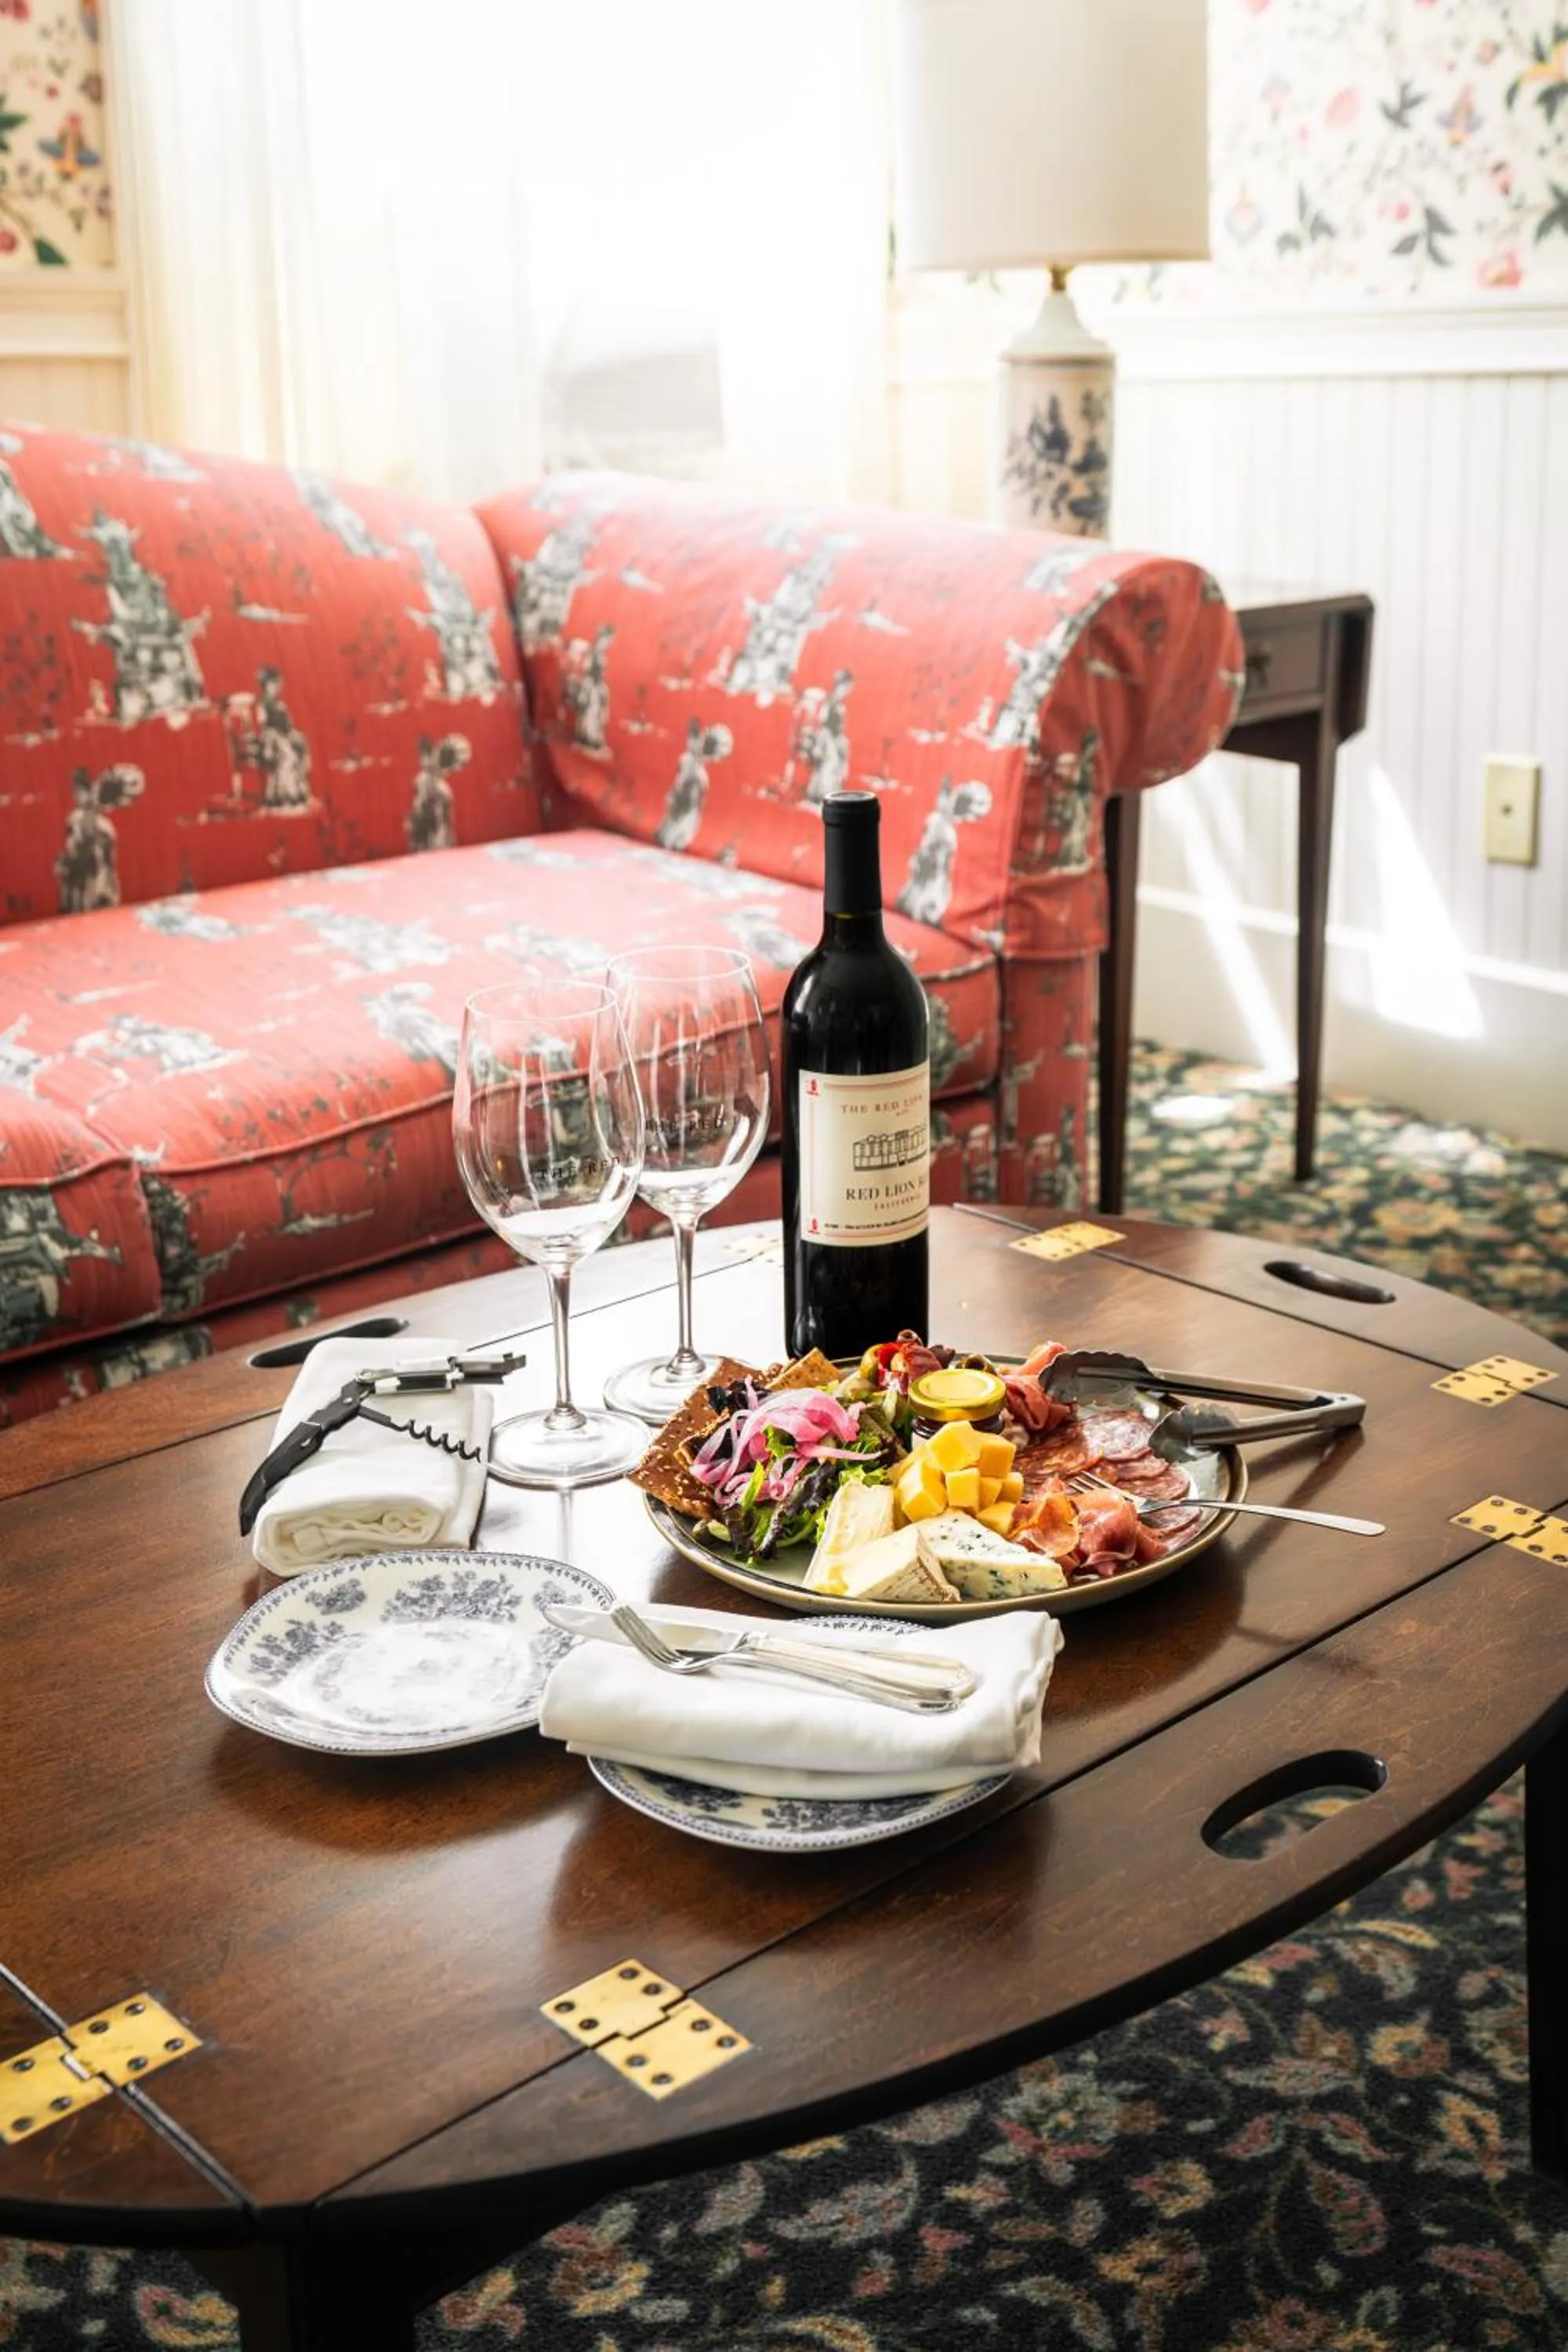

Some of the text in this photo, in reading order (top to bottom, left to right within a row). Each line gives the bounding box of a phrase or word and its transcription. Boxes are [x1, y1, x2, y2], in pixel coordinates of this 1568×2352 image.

[839, 1104, 868, 1114] THE
[874, 1101, 900, 1112] RED
[536, 1165, 577, 1178] THE
[846, 1187, 880, 1200] RED
[885, 1179, 916, 1199] LION
